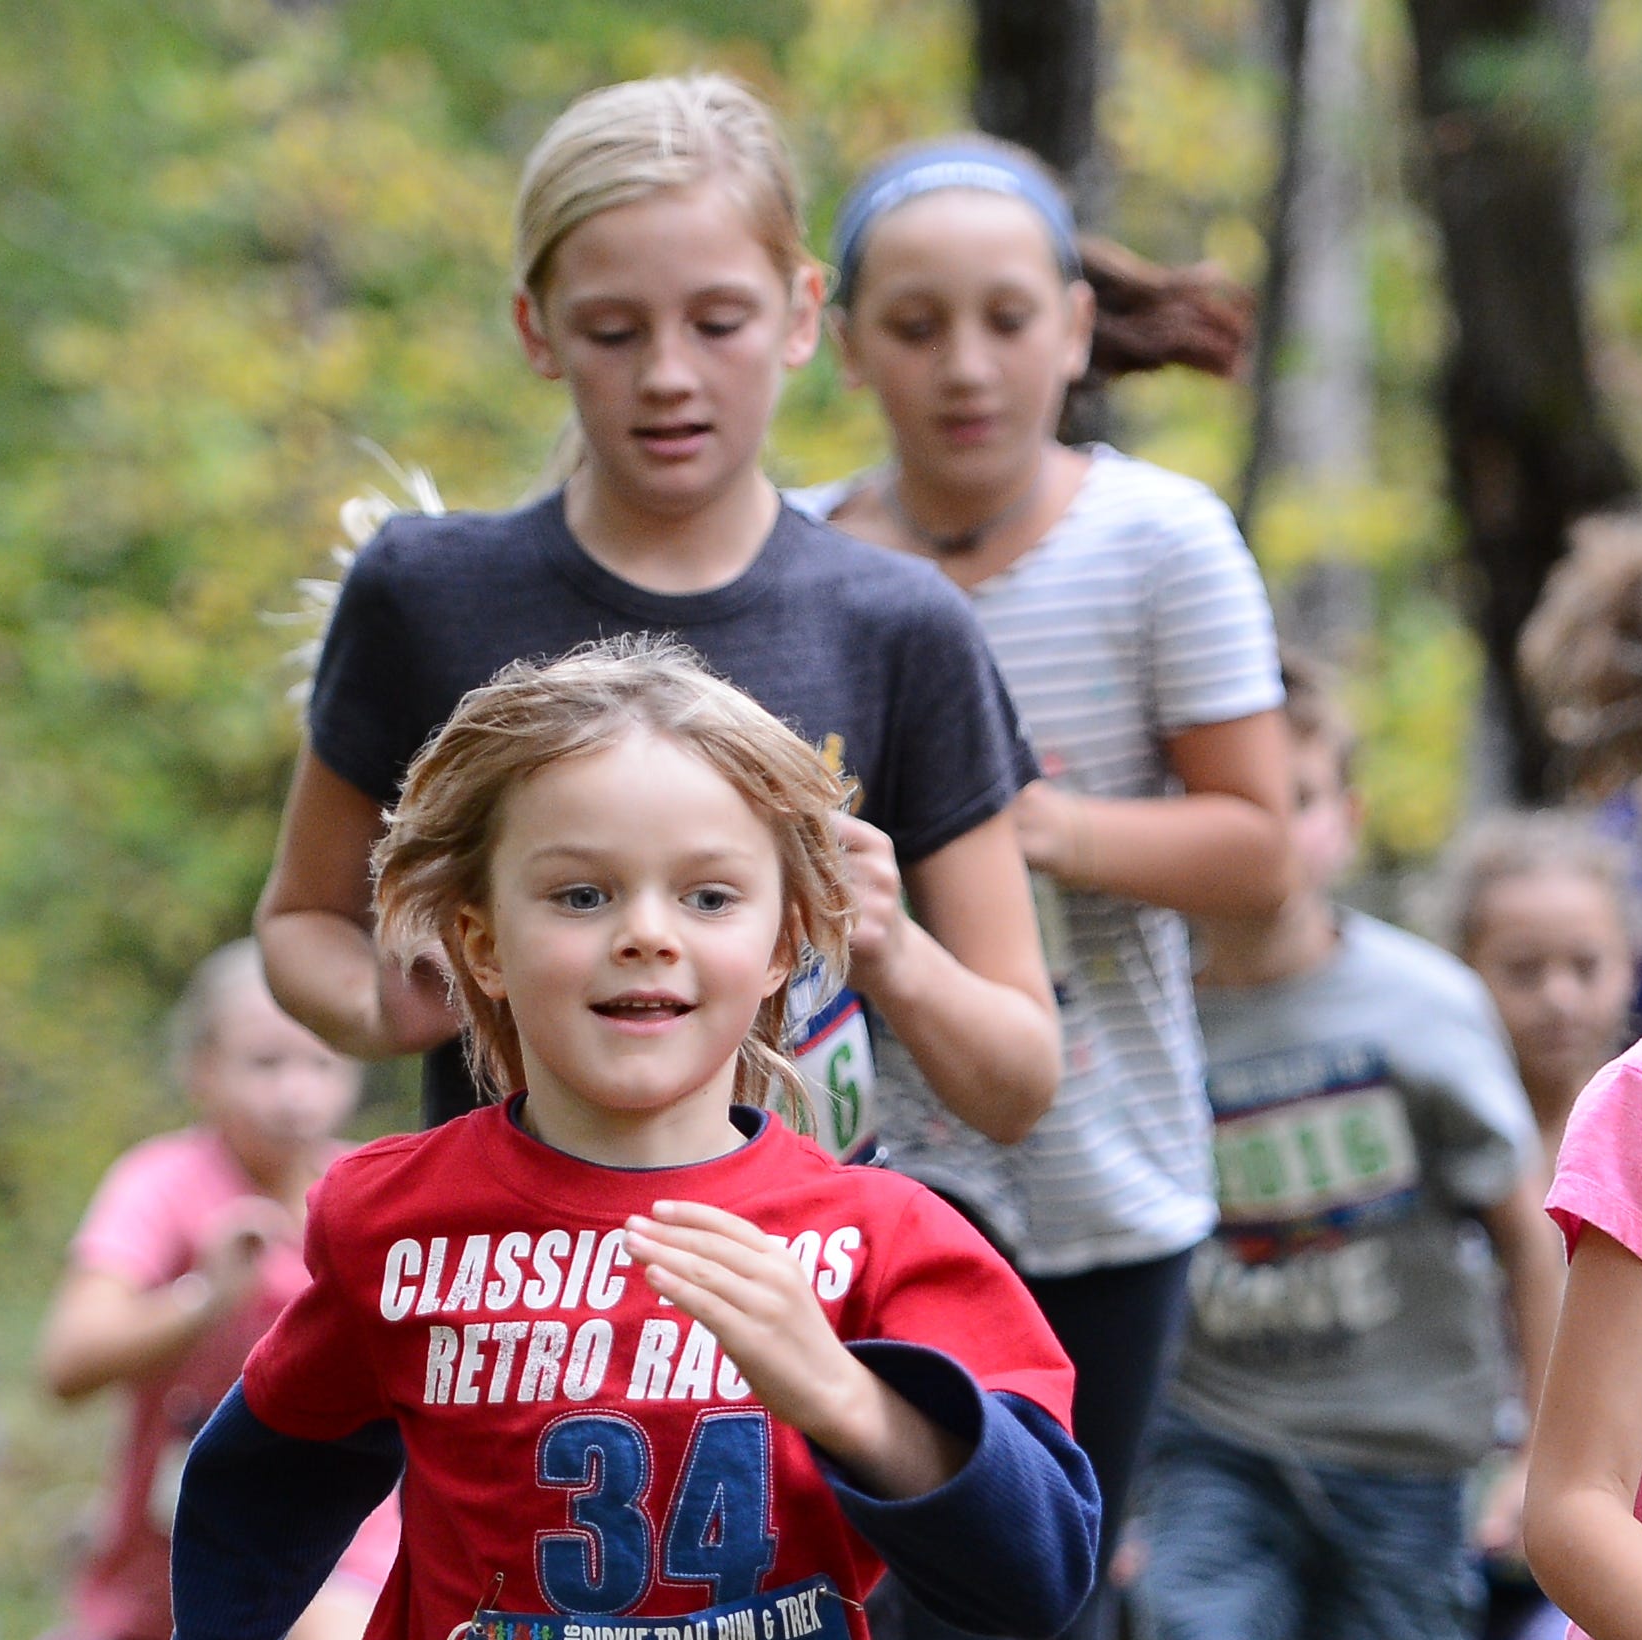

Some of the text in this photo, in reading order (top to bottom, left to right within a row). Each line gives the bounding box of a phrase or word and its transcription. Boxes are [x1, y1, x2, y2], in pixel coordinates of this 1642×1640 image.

[380, 1229, 632, 1321] CLASSIC
[423, 1320, 612, 1404] RETRO
[627, 1318, 753, 1401] RAC
[536, 1406, 779, 1616] 34
[762, 1609, 774, 1640] &
[776, 1588, 823, 1640] TREK
